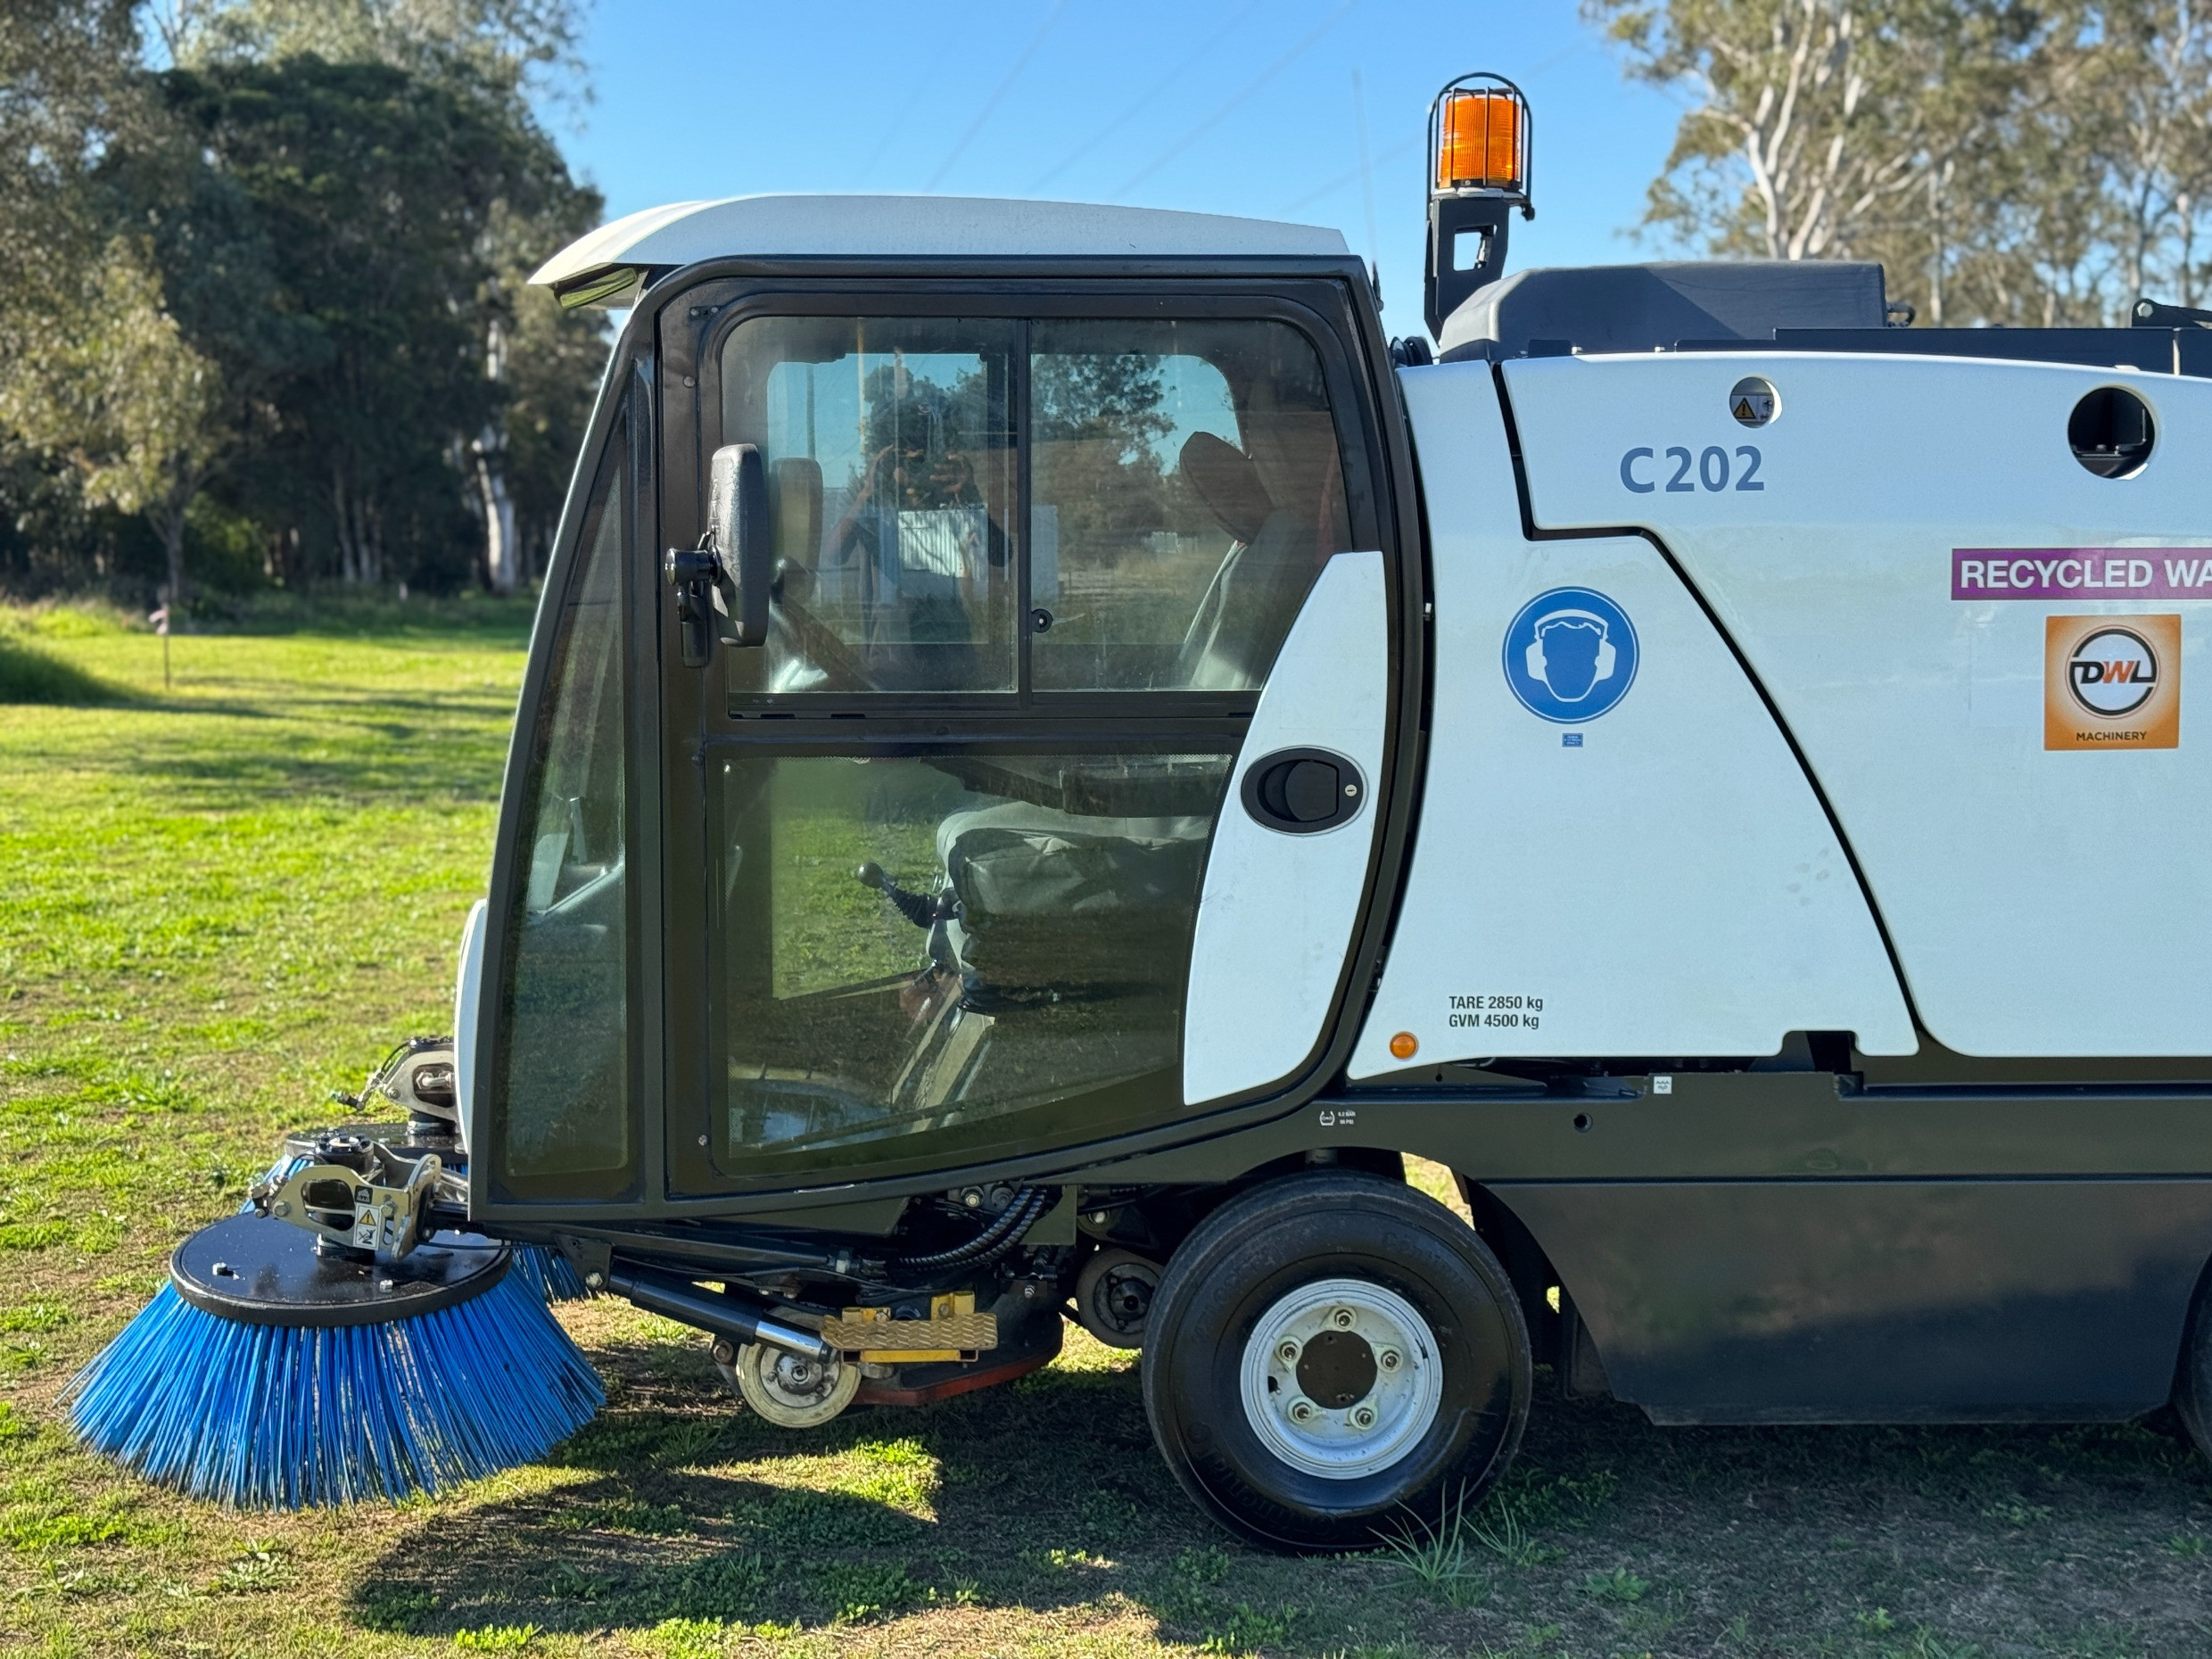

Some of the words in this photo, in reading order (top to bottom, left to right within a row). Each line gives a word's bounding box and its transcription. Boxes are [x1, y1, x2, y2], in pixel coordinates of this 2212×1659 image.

[1620, 446, 1765, 493] C202
[1960, 559, 2153, 589] RECYCLED
[2164, 559, 2212, 588] WA
[2069, 660, 2157, 684] DWL
[2076, 731, 2147, 741] MACHINERY
[1449, 995, 1484, 1009] TARE
[1489, 995, 1522, 1009] 2850
[1527, 995, 1543, 1011] kg
[1449, 1014, 1480, 1028] GVM
[1484, 1014, 1518, 1028] 4500
[1523, 1014, 1539, 1029] kg
